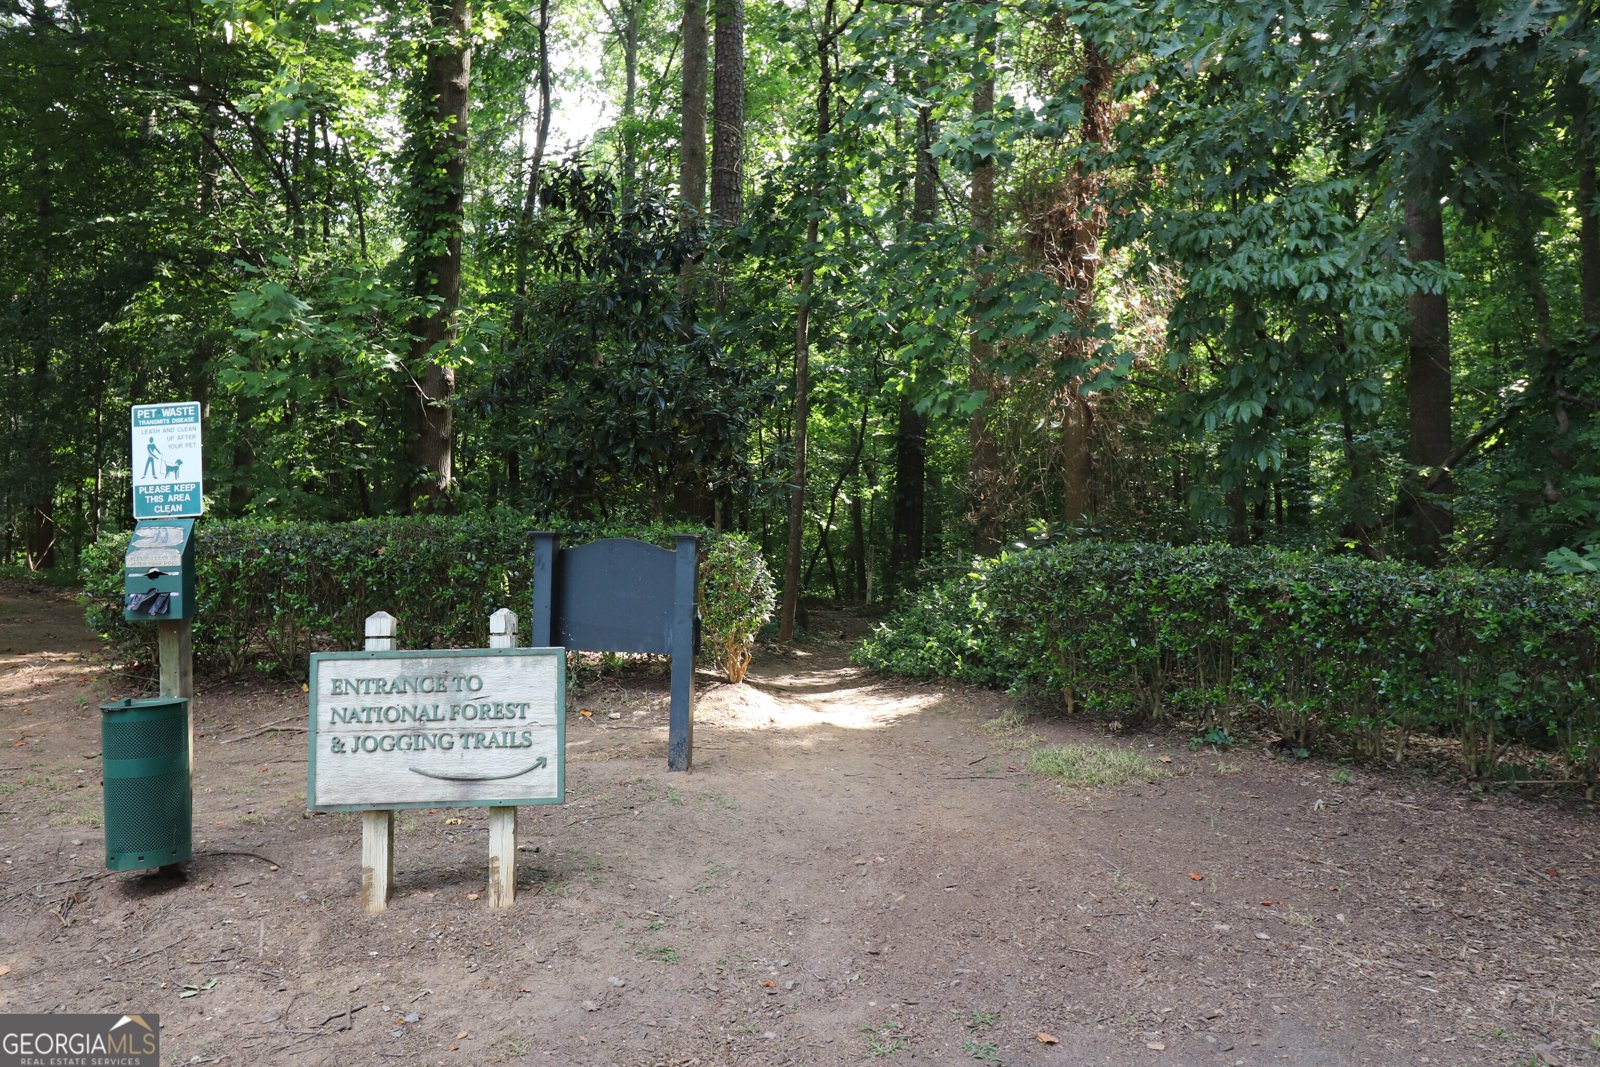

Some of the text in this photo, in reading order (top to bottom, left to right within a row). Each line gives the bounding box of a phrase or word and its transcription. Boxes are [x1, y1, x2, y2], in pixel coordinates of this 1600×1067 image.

[137, 406, 195, 419] PET WASTE
[139, 483, 196, 494] PLEASE KEEP
[145, 494, 191, 503] THIS AREA
[154, 504, 183, 513] CLEAN
[330, 674, 484, 696] ENTRANCE TO
[330, 702, 530, 724] NATIONAL FOREST
[331, 731, 533, 754] & JOGGING TRAILS
